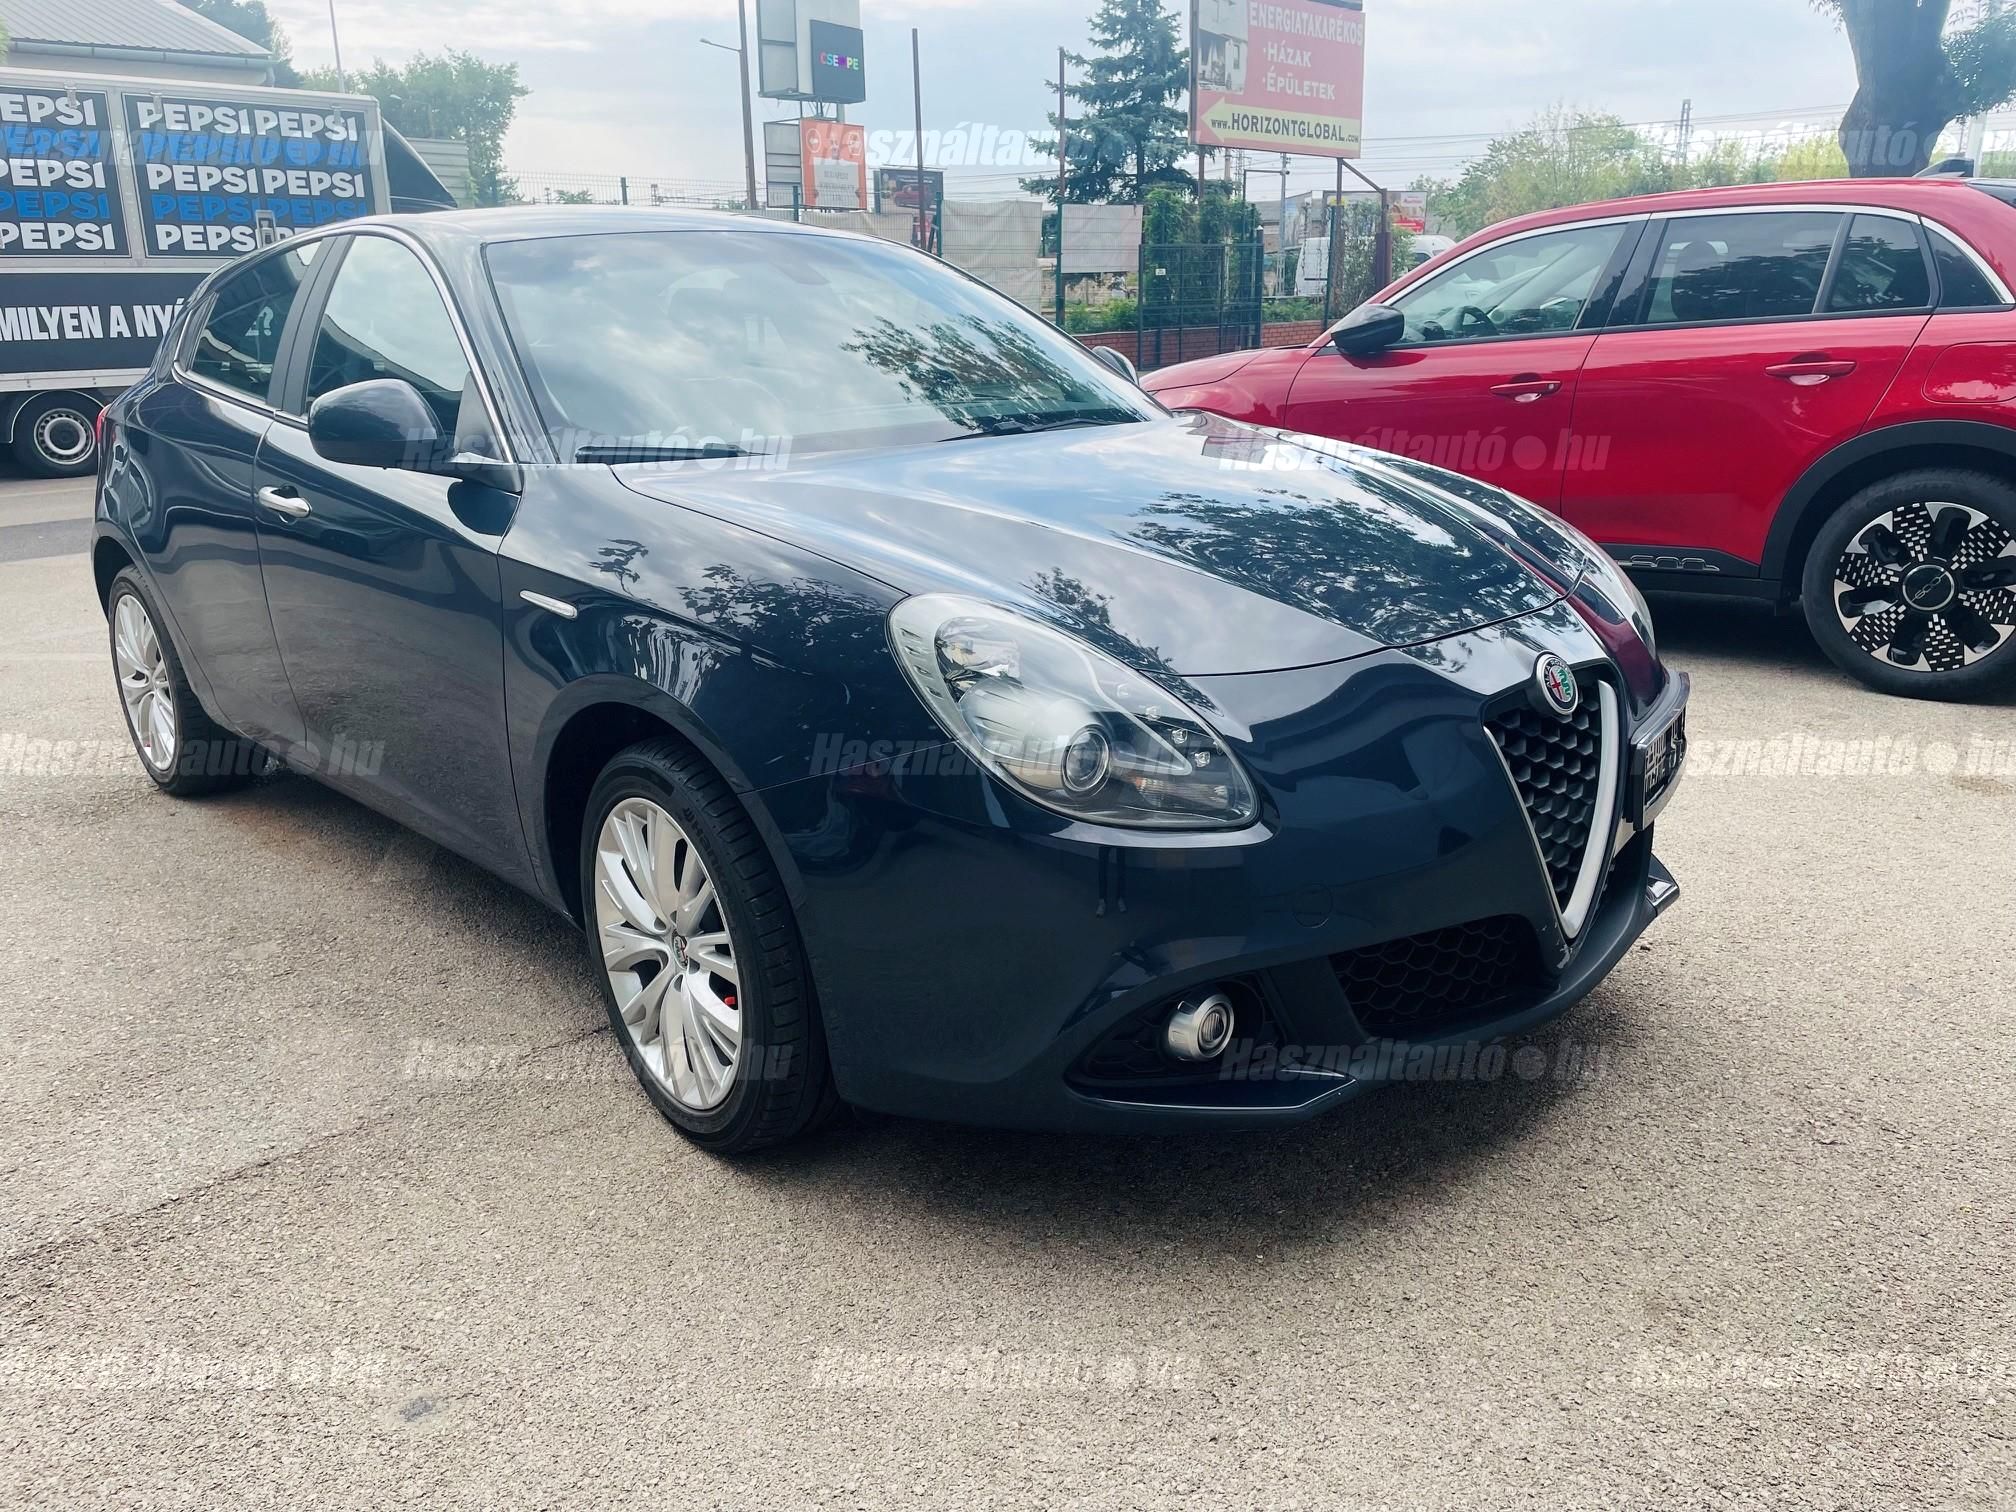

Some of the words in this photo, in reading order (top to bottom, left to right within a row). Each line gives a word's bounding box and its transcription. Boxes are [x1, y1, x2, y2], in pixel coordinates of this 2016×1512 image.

[1267, 40, 1312, 67] HÁZAK
[1267, 65, 1336, 100] ÉPÜLETEK
[137, 101, 250, 134] PEPSI
[254, 109, 358, 141] PEPSI
[142, 132, 254, 164] PEPSI
[258, 137, 361, 169] PEPSI
[146, 163, 258, 194] PEPSI
[262, 168, 365, 198] PEPSI
[155, 224, 259, 251] PEPS
[0, 305, 103, 342] MILYEN
[110, 305, 131, 338] A
[133, 297, 184, 338] NY
